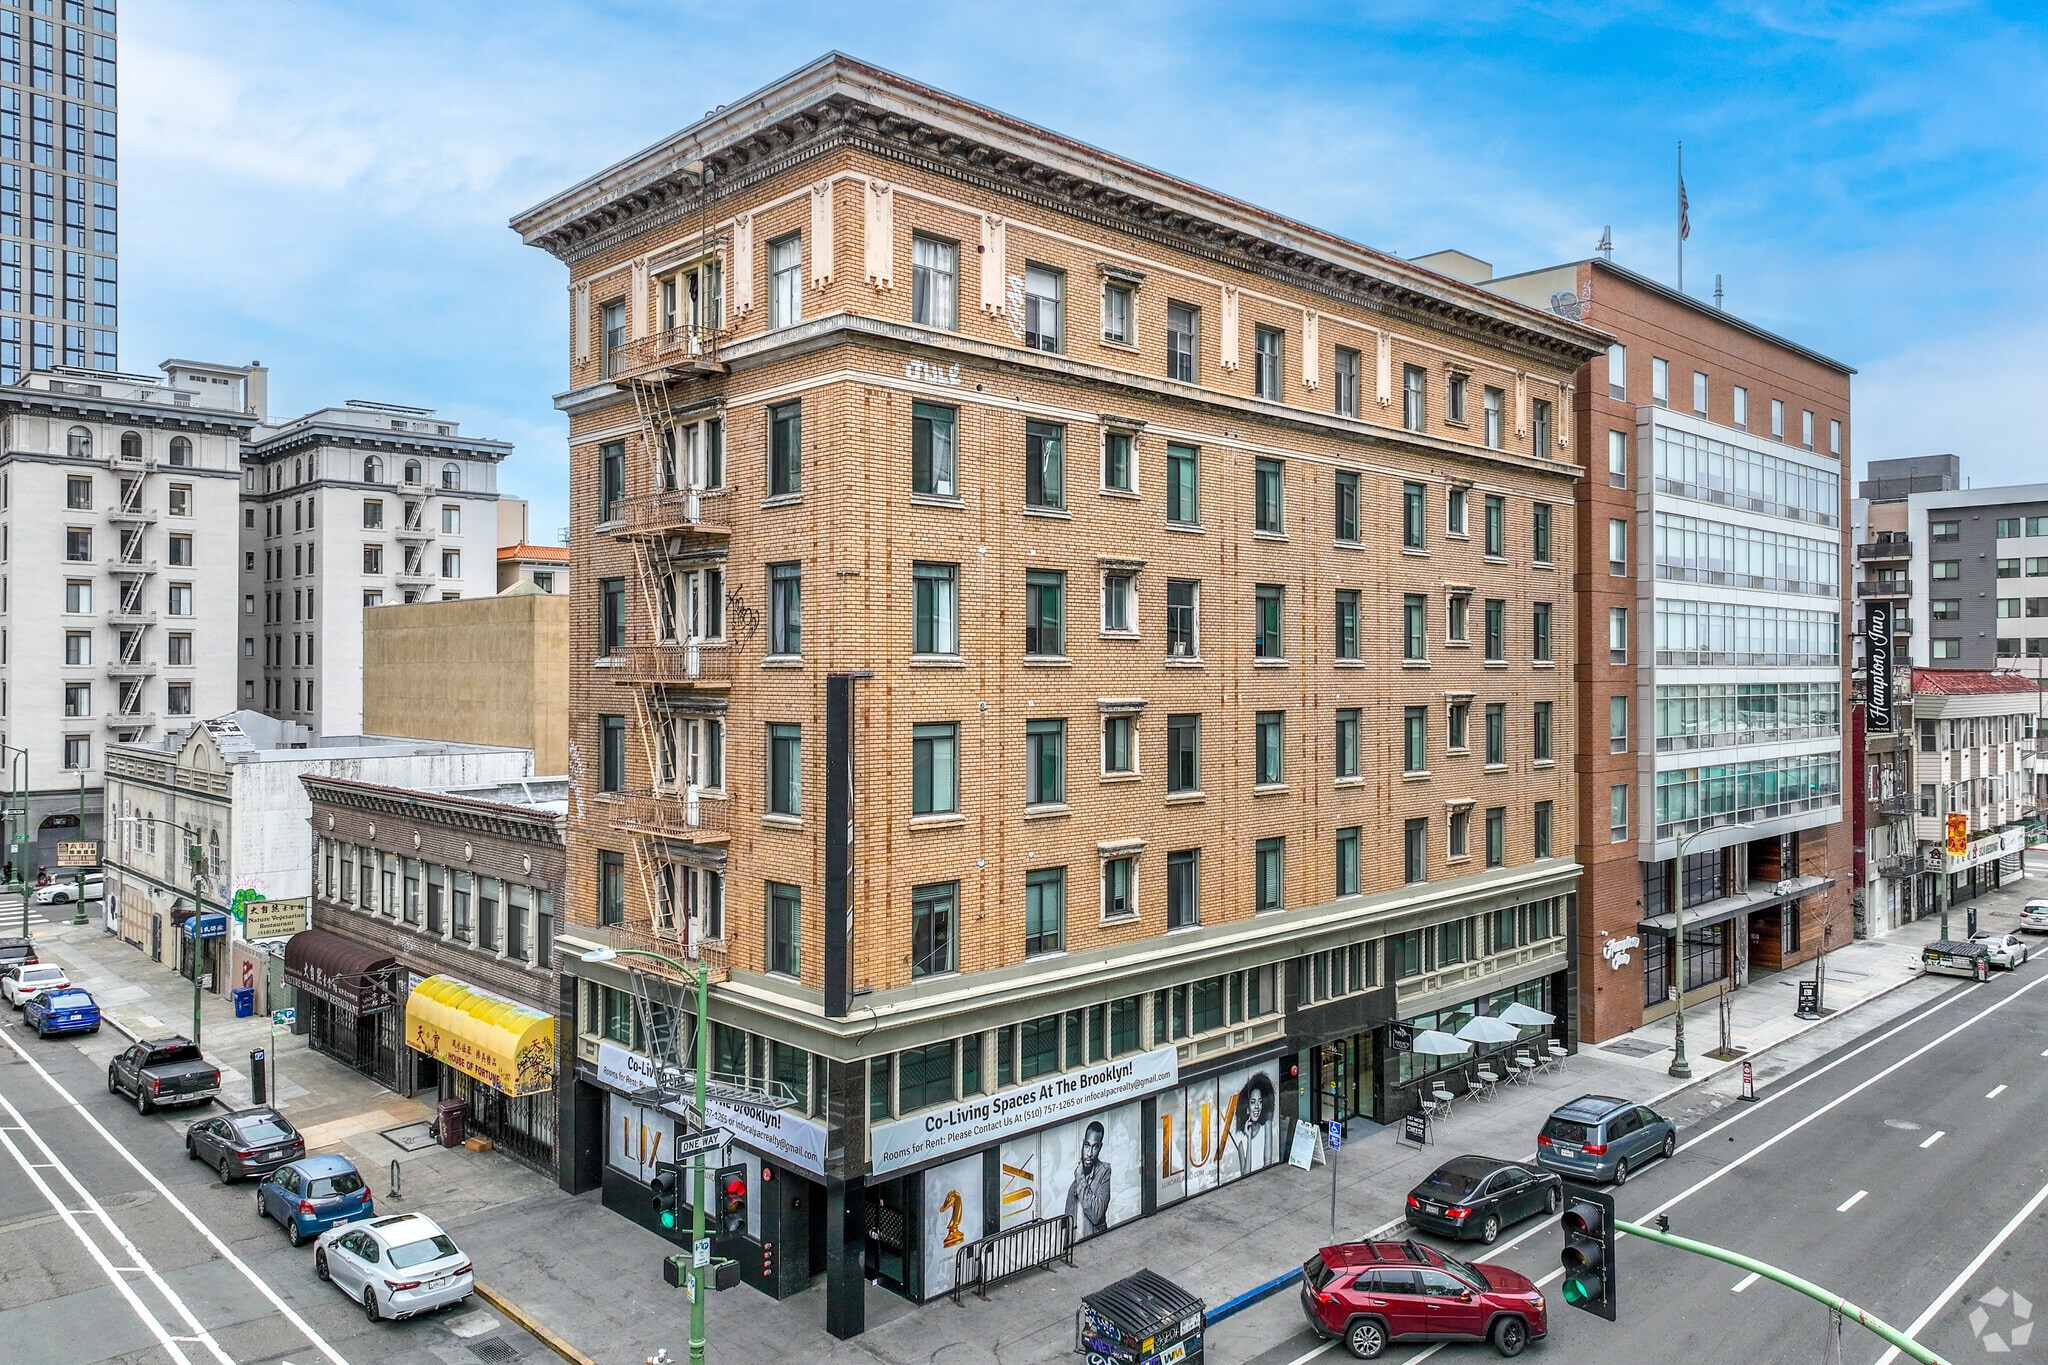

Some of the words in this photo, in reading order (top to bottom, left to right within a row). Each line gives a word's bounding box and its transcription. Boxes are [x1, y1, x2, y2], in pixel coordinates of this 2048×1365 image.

[1868, 609, 1889, 646] Inn
[1868, 648, 1889, 725] Hampton
[260, 921, 294, 929] Restaurant
[271, 913, 305, 921] Vegetarian
[284, 974, 301, 988] NATURE
[301, 980, 329, 1000] VEGETARIAN
[329, 993, 359, 1016] RESTAURANT
[448, 1052, 465, 1067] HOUSE
[466, 1061, 474, 1071] OF
[475, 1065, 501, 1085] FORTUNE
[603, 1066, 618, 1080] Rooms
[618, 1071, 626, 1081] for
[626, 1074, 639, 1087] Rent:
[925, 1104, 990, 1132] Co-Living
[993, 1091, 1037, 1115] Spaces
[1039, 1083, 1053, 1101] At
[1055, 1079, 1077, 1095] The
[1080, 1061, 1134, 1089] Brooklyn!
[883, 1147, 911, 1162] Rooms
[912, 1142, 924, 1153] for
[925, 1136, 946, 1149] Rent:
[947, 1129, 973, 1144] Please
[973, 1121, 1002, 1136] Contact
[1003, 1117, 1013, 1126] Us
[1014, 1114, 1022, 1123] At
[1023, 1106, 1042, 1122] (510)
[1044, 1098, 1075, 1114] 757-1265
[1076, 1096, 1083, 1105] or
[1084, 1070, 1171, 1103] infocalpacrealty@gmail.com
[1407, 1126, 1424, 1135] CHEESE
[623, 1116, 662, 1168] LUX
[683, 1140, 700, 1151] ONE
[702, 1134, 719, 1146] WAY
[728, 1117, 735, 1126] or
[735, 1120, 818, 1162] infocalpacrealty@gmail.com
[1161, 1093, 1240, 1179] LUX
[1164, 1347, 1183, 1364] WM
